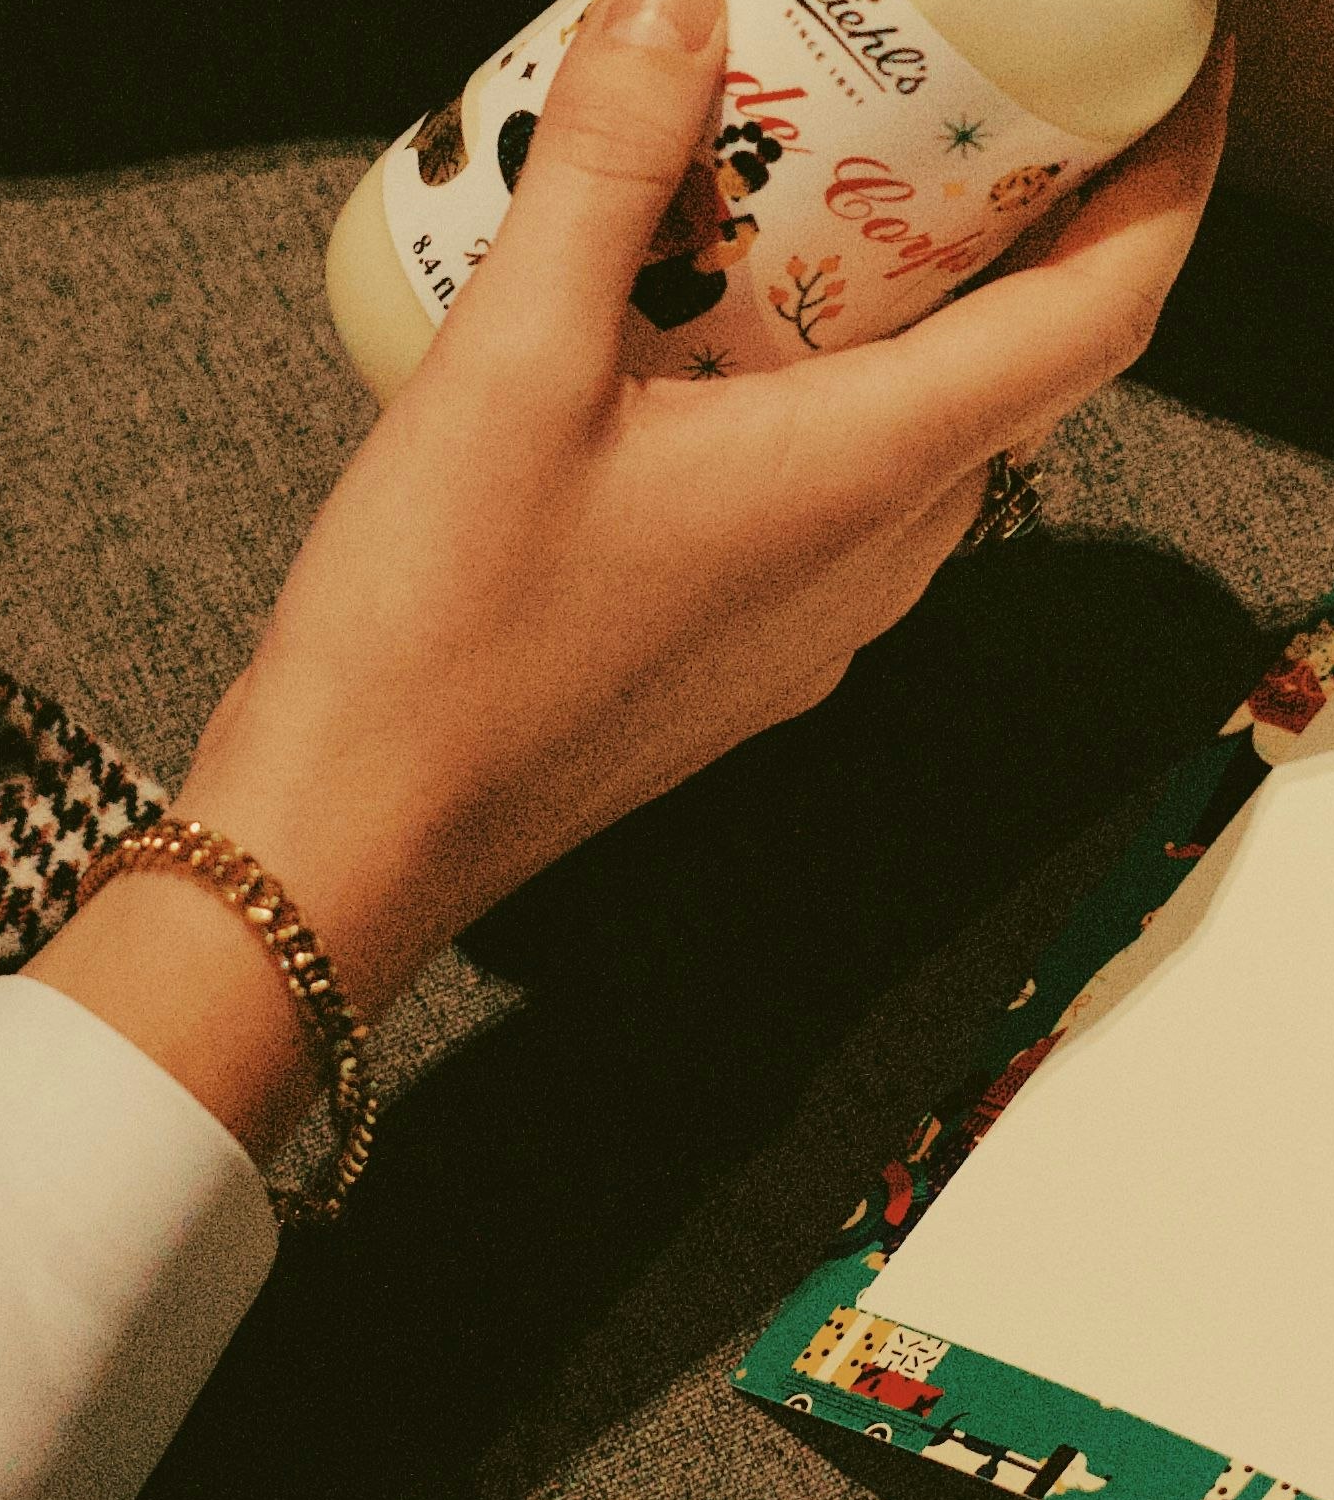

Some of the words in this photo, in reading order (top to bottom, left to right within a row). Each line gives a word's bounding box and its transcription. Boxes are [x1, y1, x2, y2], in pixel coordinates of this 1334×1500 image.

[785, 7, 826, 62] SINCE
[829, 66, 865, 107] 1851
[413, 234, 442, 276] 8.4
[432, 276, 456, 311] fl.
